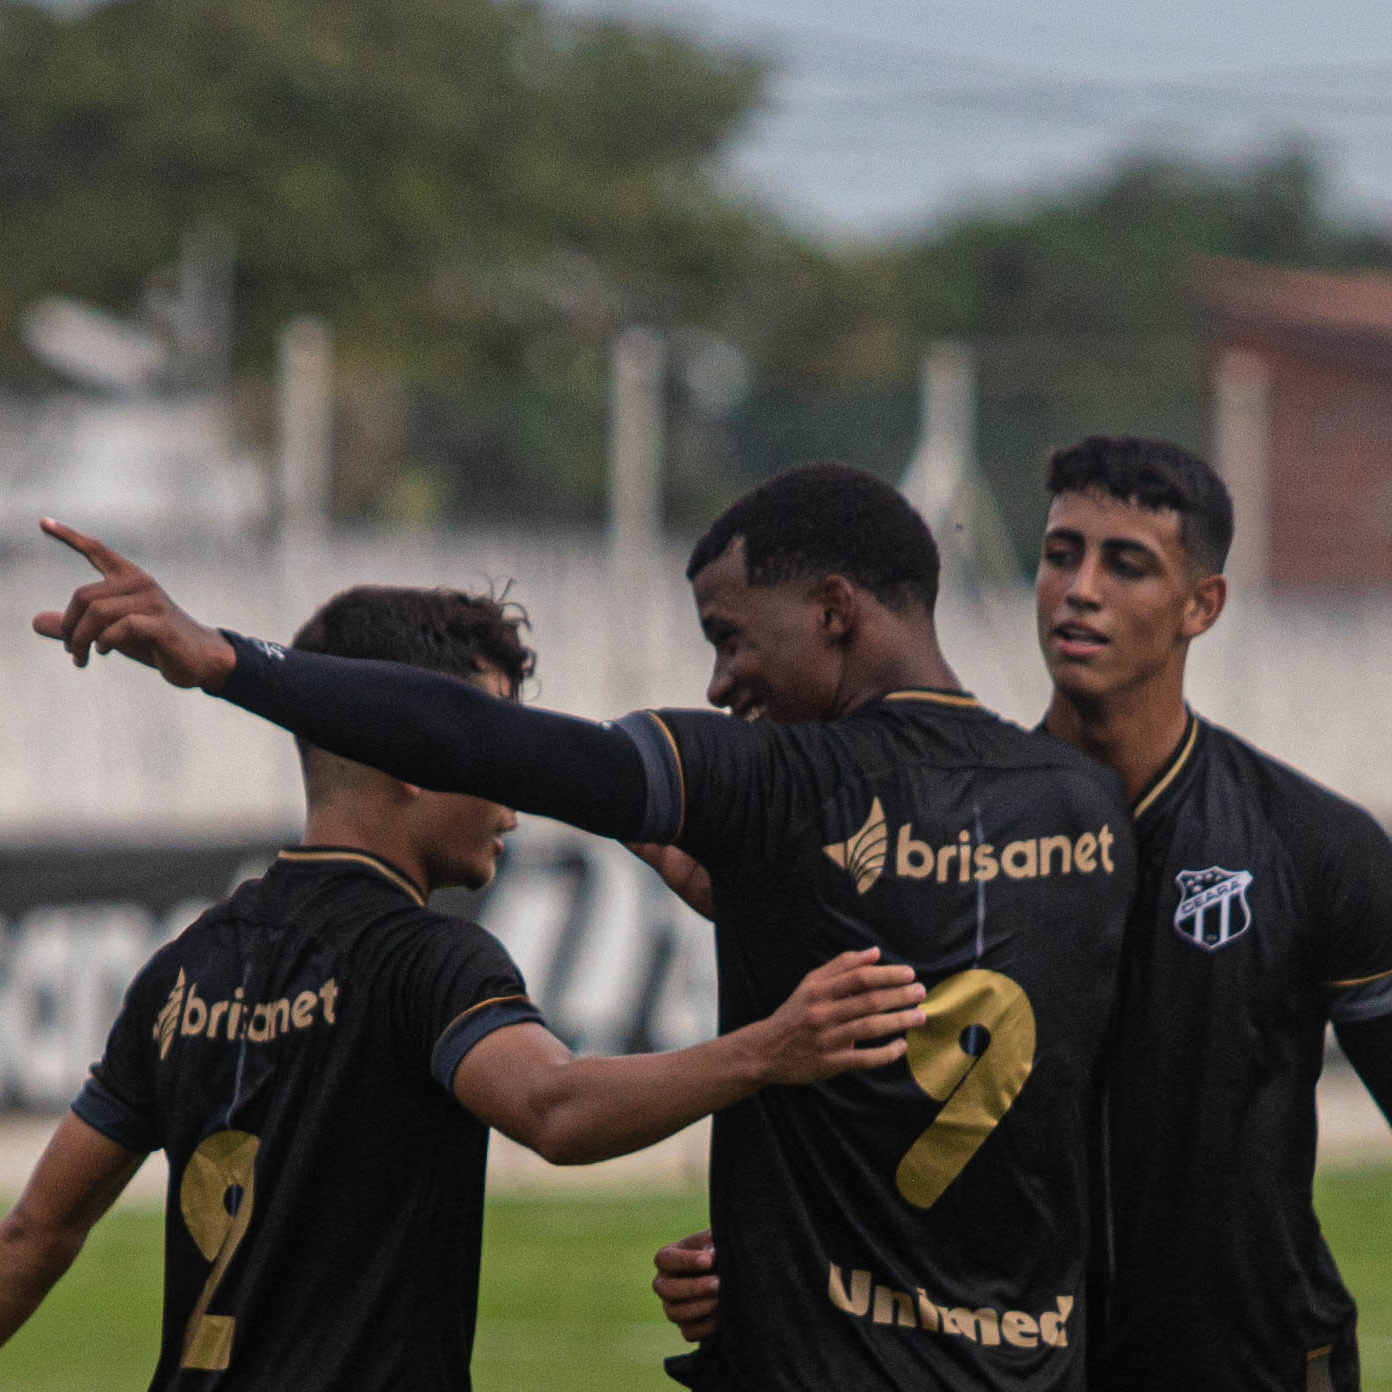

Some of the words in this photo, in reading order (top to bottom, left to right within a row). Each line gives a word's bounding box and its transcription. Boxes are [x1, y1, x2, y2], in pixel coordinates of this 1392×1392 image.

[896, 823, 1115, 883] brisanet
[896, 968, 1037, 1209] 9
[179, 1130, 262, 1371] 2
[828, 1261, 1075, 1347] Unimed
